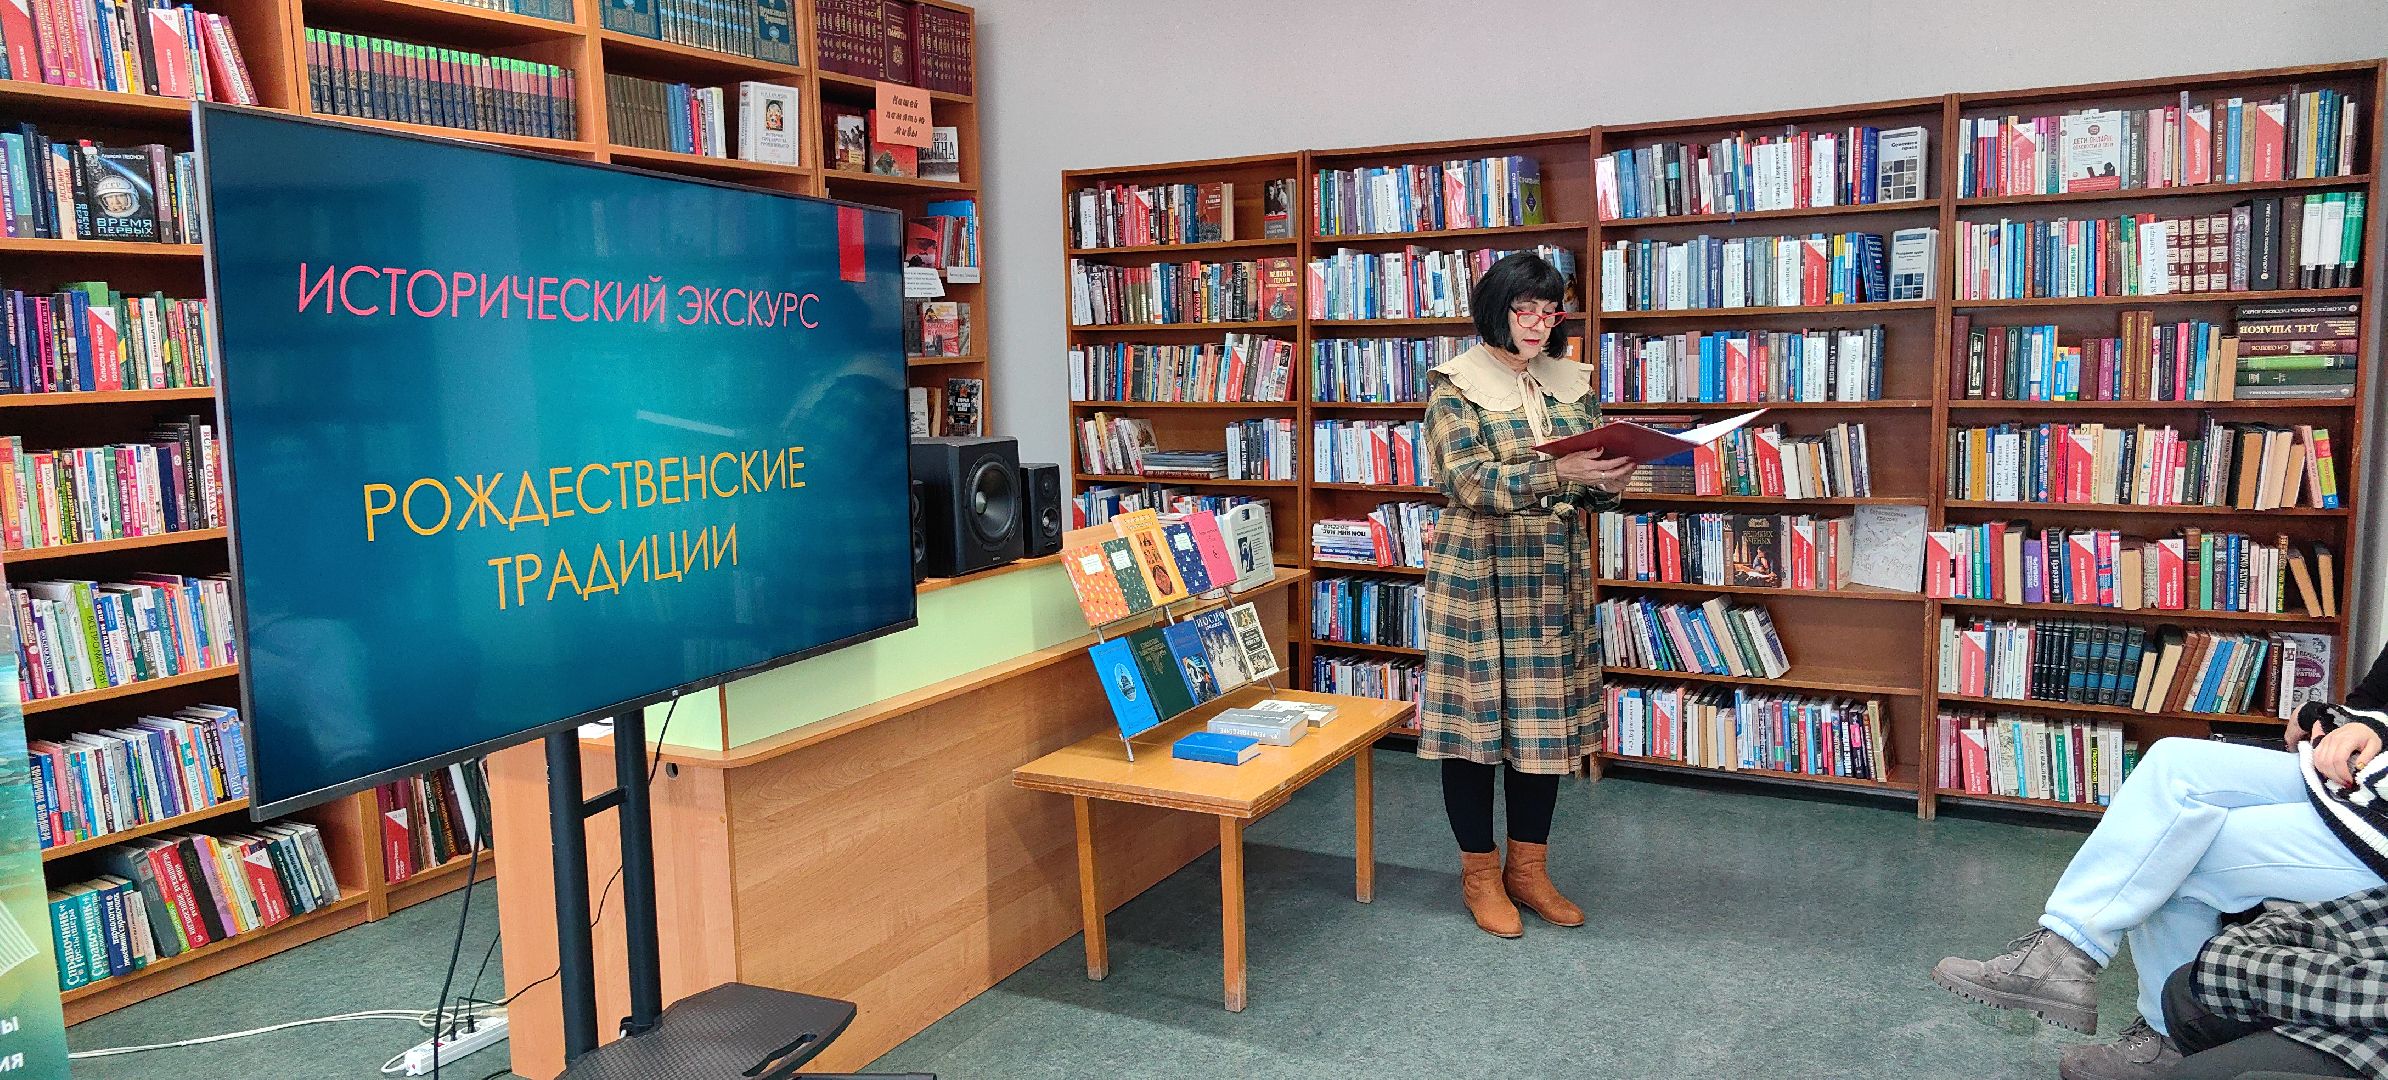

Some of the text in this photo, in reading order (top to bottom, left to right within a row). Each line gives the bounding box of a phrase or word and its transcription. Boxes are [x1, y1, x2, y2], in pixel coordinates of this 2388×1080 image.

[167, 49, 177, 92] Строительство
[893, 95, 918, 109] Нашей
[886, 112, 925, 124] памятью
[894, 126, 918, 138] живы
[81, 204, 91, 236] ВРЕМЯ
[97, 218, 152, 227] ВРЕМЯ
[98, 226, 153, 235] ПЕРВЫХ
[297, 262, 819, 329] ИСТОРИЧЕСКИЙ ЭКСКУРС
[95, 324, 103, 347] лесное
[2239, 325, 2291, 333] УШАКОВ
[97, 352, 108, 382] Сельское
[203, 431, 212, 451] ВСЕ
[206, 464, 216, 512] СОБАКАХ
[363, 446, 805, 542] РОЖДЕСТВЕНСКИЕ
[488, 522, 737, 610] ТРАДИЦИИ
[87, 615, 97, 630] ВСЕ
[59, 910, 85, 985] Справочник
[69, 908, 84, 962] фельдшера
[83, 904, 107, 976] Справочник
